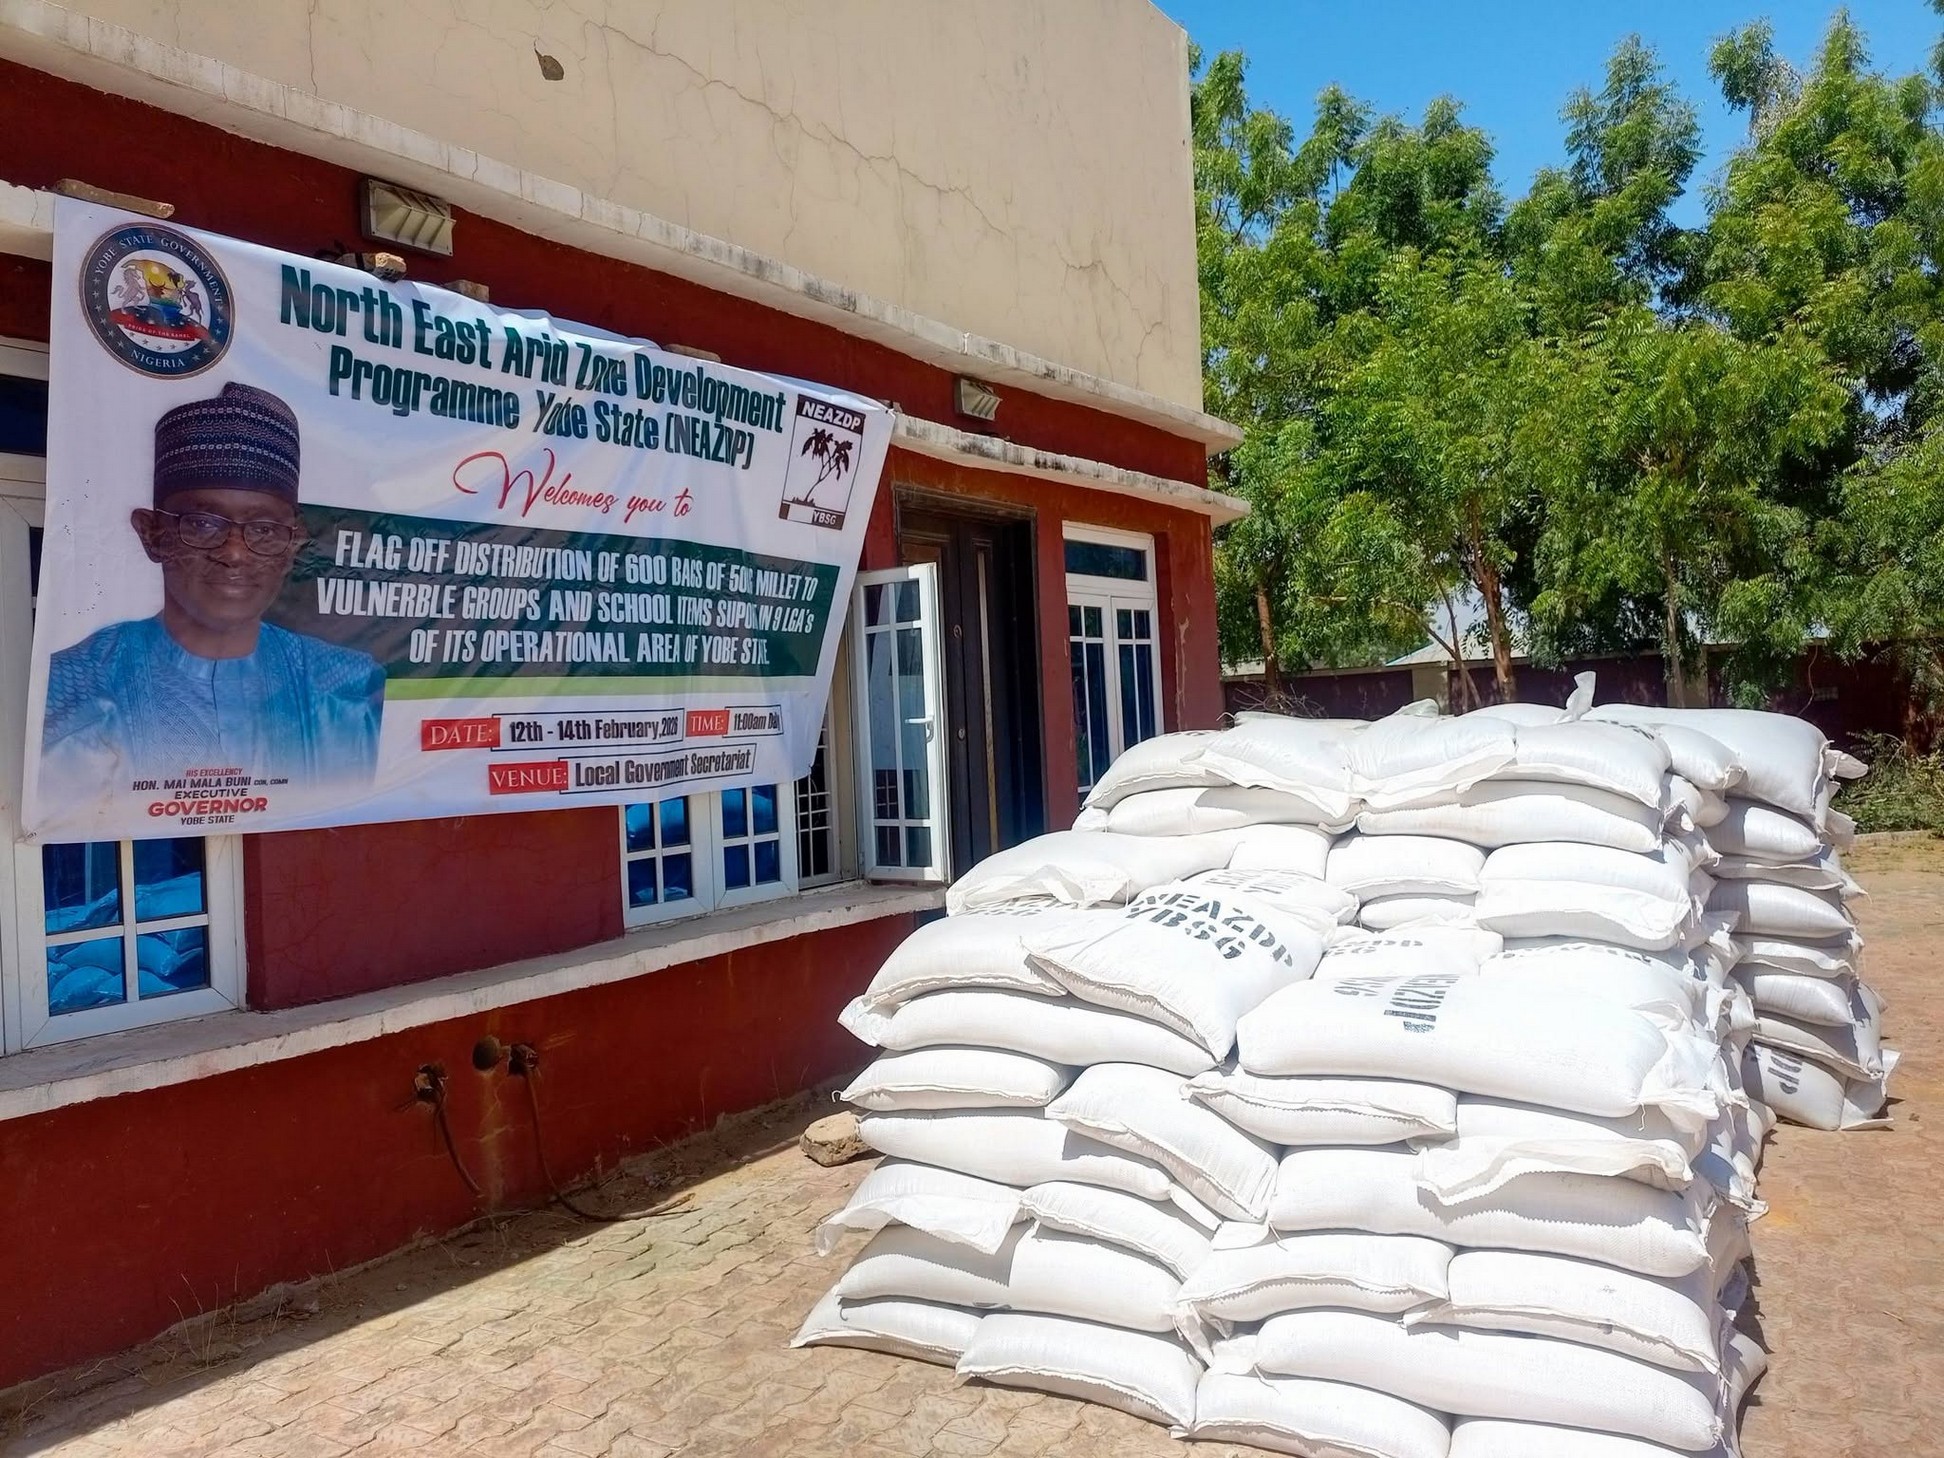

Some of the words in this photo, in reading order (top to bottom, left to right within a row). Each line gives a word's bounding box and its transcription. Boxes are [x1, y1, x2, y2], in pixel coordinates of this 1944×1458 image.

[95, 247, 116, 274] YOBE
[119, 234, 153, 249] STATE
[160, 237, 223, 303] GOVERNMENT
[130, 349, 186, 368] NIGERIA
[280, 264, 403, 349] North
[411, 298, 492, 370] East
[501, 326, 569, 387] Arid
[634, 352, 787, 434] Development
[329, 345, 520, 430] Programme
[594, 400, 659, 450] State
[802, 401, 861, 430] NEAZDP
[453, 447, 619, 518] Welcomes
[624, 494, 667, 524] you
[673, 487, 694, 517] to
[812, 510, 837, 525] YBSG
[335, 529, 402, 571] FLAG
[407, 536, 451, 574] OFF
[454, 541, 592, 581] DISTRIBUTION
[597, 551, 620, 583] OF
[624, 553, 667, 586] 600
[706, 561, 727, 591] OF
[756, 569, 802, 600] MILLET
[801, 576, 819, 601] TO
[317, 577, 457, 619] VULNERBLE
[461, 586, 541, 621] GROUPS
[549, 589, 593, 622] AND
[597, 591, 674, 624] SCHOOL
[759, 604, 774, 631] IN
[772, 606, 783, 632] 9
[781, 606, 815, 634] LGA's
[409, 629, 440, 664] OF
[442, 629, 477, 663] ITS
[480, 630, 630, 663] OPERATIONAL
[637, 632, 680, 663] AREA
[684, 635, 699, 663] OF
[701, 635, 739, 665] YOBE
[431, 723, 493, 745] DATE:
[509, 720, 543, 743] 12th
[557, 719, 592, 741] 14th
[690, 714, 724, 732] TIME:
[733, 713, 767, 731] 11:00am
[132, 780, 160, 791] HON.
[164, 778, 187, 790] MAI
[190, 777, 222, 789] MALA
[225, 776, 252, 787] BUNI
[200, 767, 243, 777] EXCELLENCY
[492, 767, 568, 788] VENUE:
[575, 760, 620, 787] Local
[690, 749, 751, 776] Secretariat
[147, 797, 268, 818] GOVERNOR
[174, 788, 249, 800] EXECUTIVE
[180, 816, 206, 826] YOBE
[207, 814, 235, 825] STATE
[1131, 893, 1293, 968] NEAZDP
